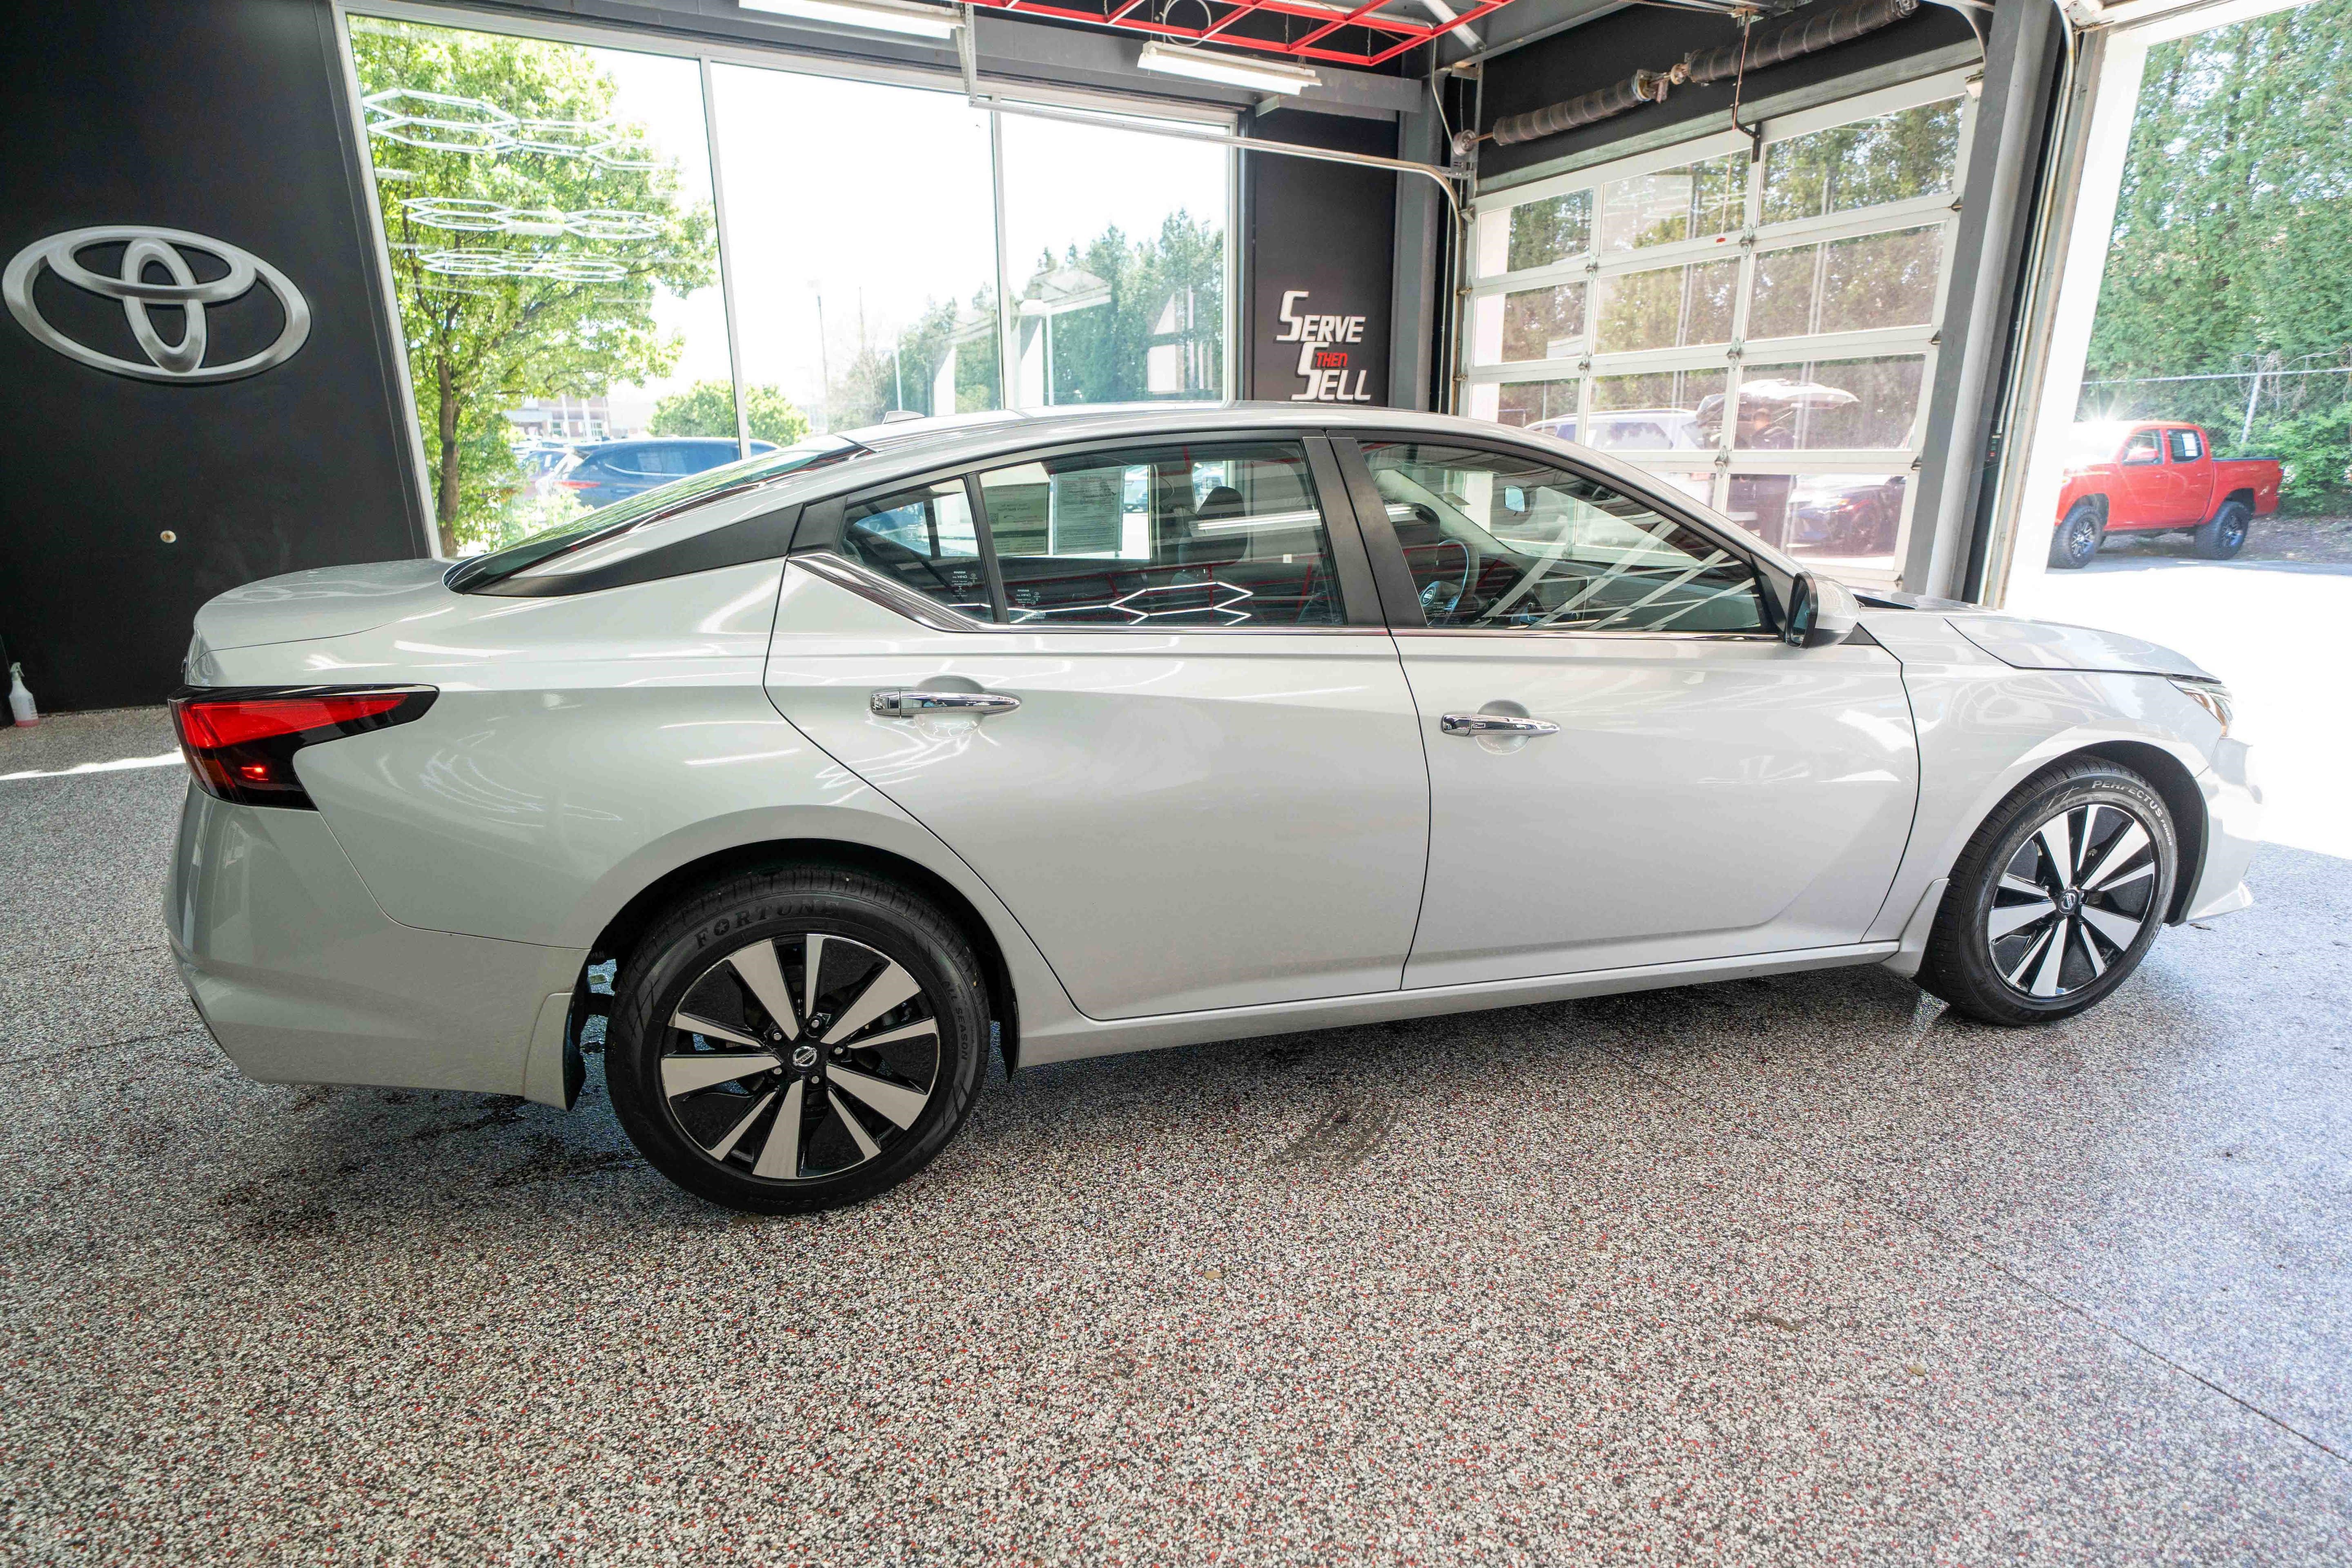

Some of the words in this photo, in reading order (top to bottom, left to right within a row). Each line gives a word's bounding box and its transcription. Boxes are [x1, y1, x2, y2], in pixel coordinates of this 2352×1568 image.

[1276, 290, 1366, 343] SERVE
[1291, 341, 1372, 401] SELL
[1316, 352, 1348, 367] THEN
[2091, 780, 2163, 817] PERFECTUS
[955, 1007, 968, 1060] SEASON
